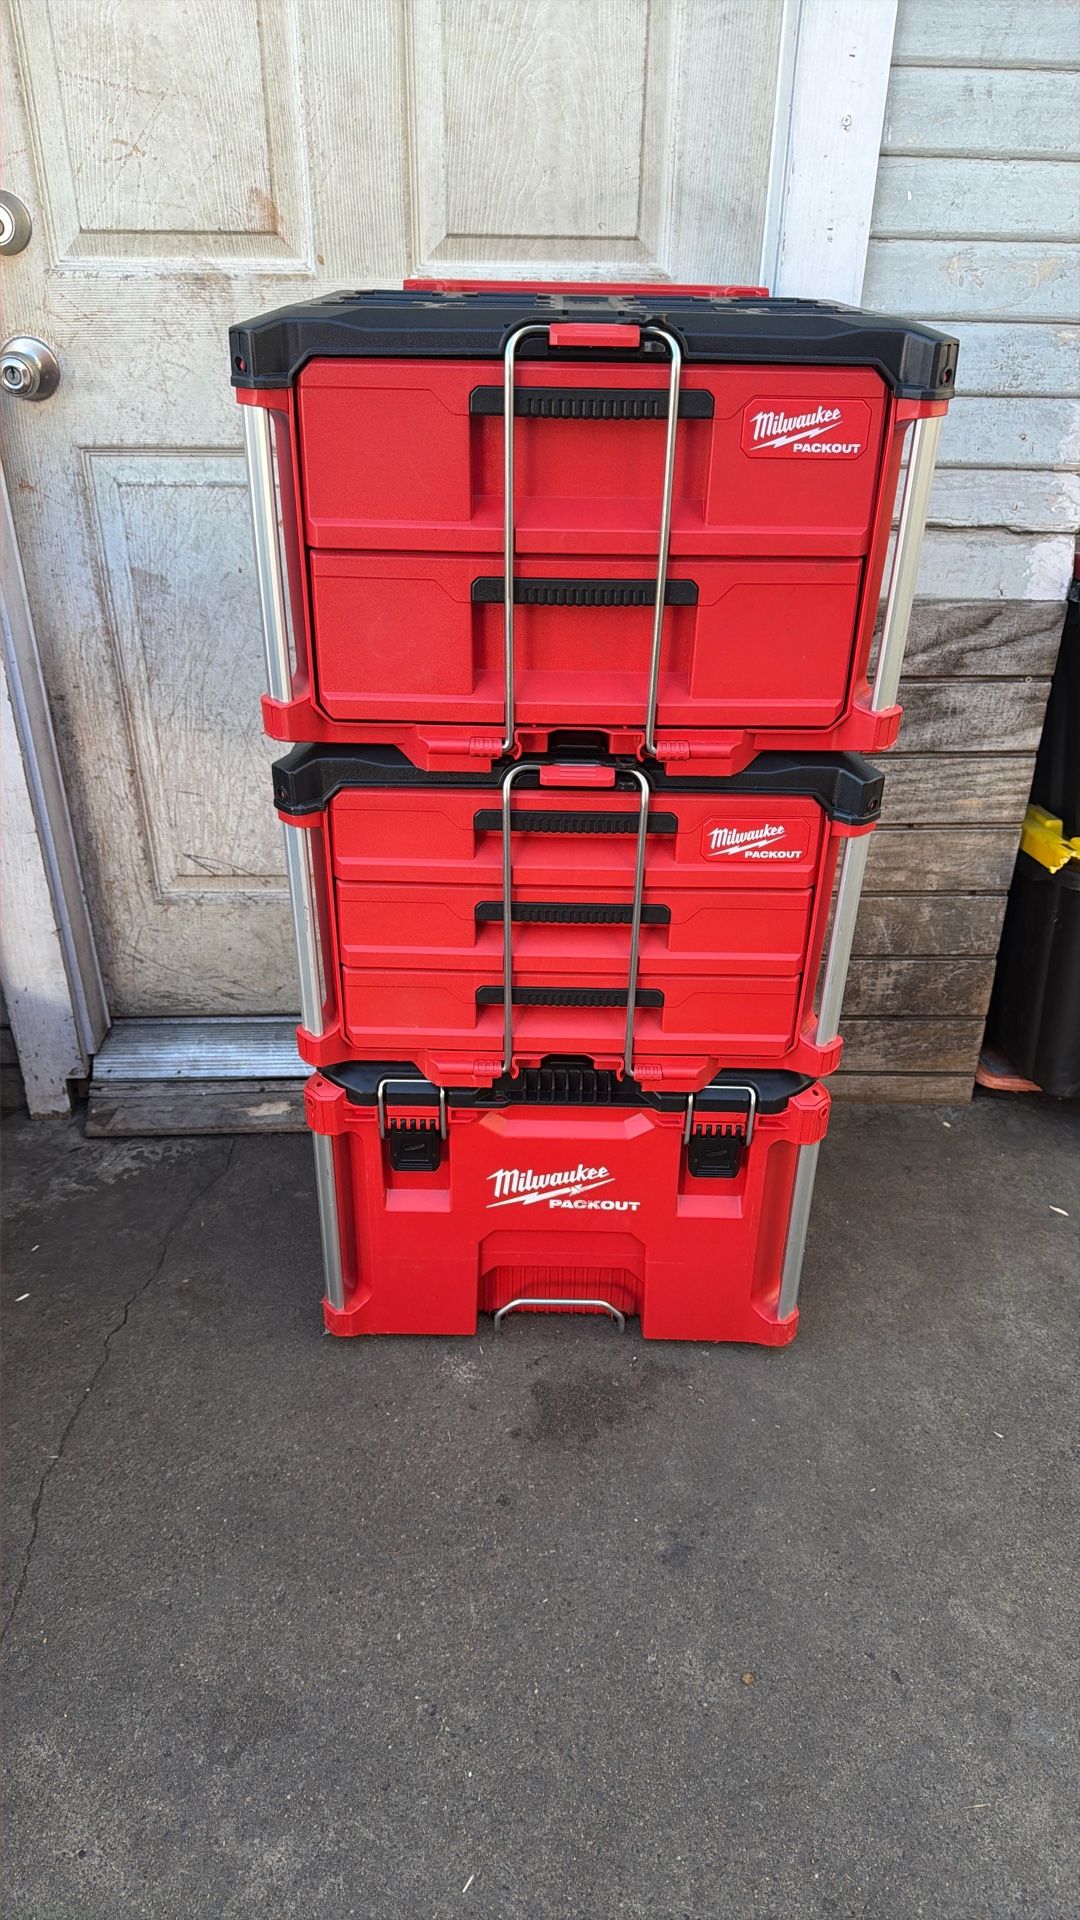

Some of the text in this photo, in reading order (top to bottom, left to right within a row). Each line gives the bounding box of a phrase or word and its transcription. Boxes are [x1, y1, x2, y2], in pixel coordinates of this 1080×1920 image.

[749, 406, 842, 441] Milwaukee
[793, 443, 861, 454] PACKOUT
[707, 824, 785, 849] Milwaukee
[745, 851, 803, 859] PACKOUT
[486, 1163, 610, 1198] Milwaukee
[549, 1199, 641, 1211] PACKOUT
